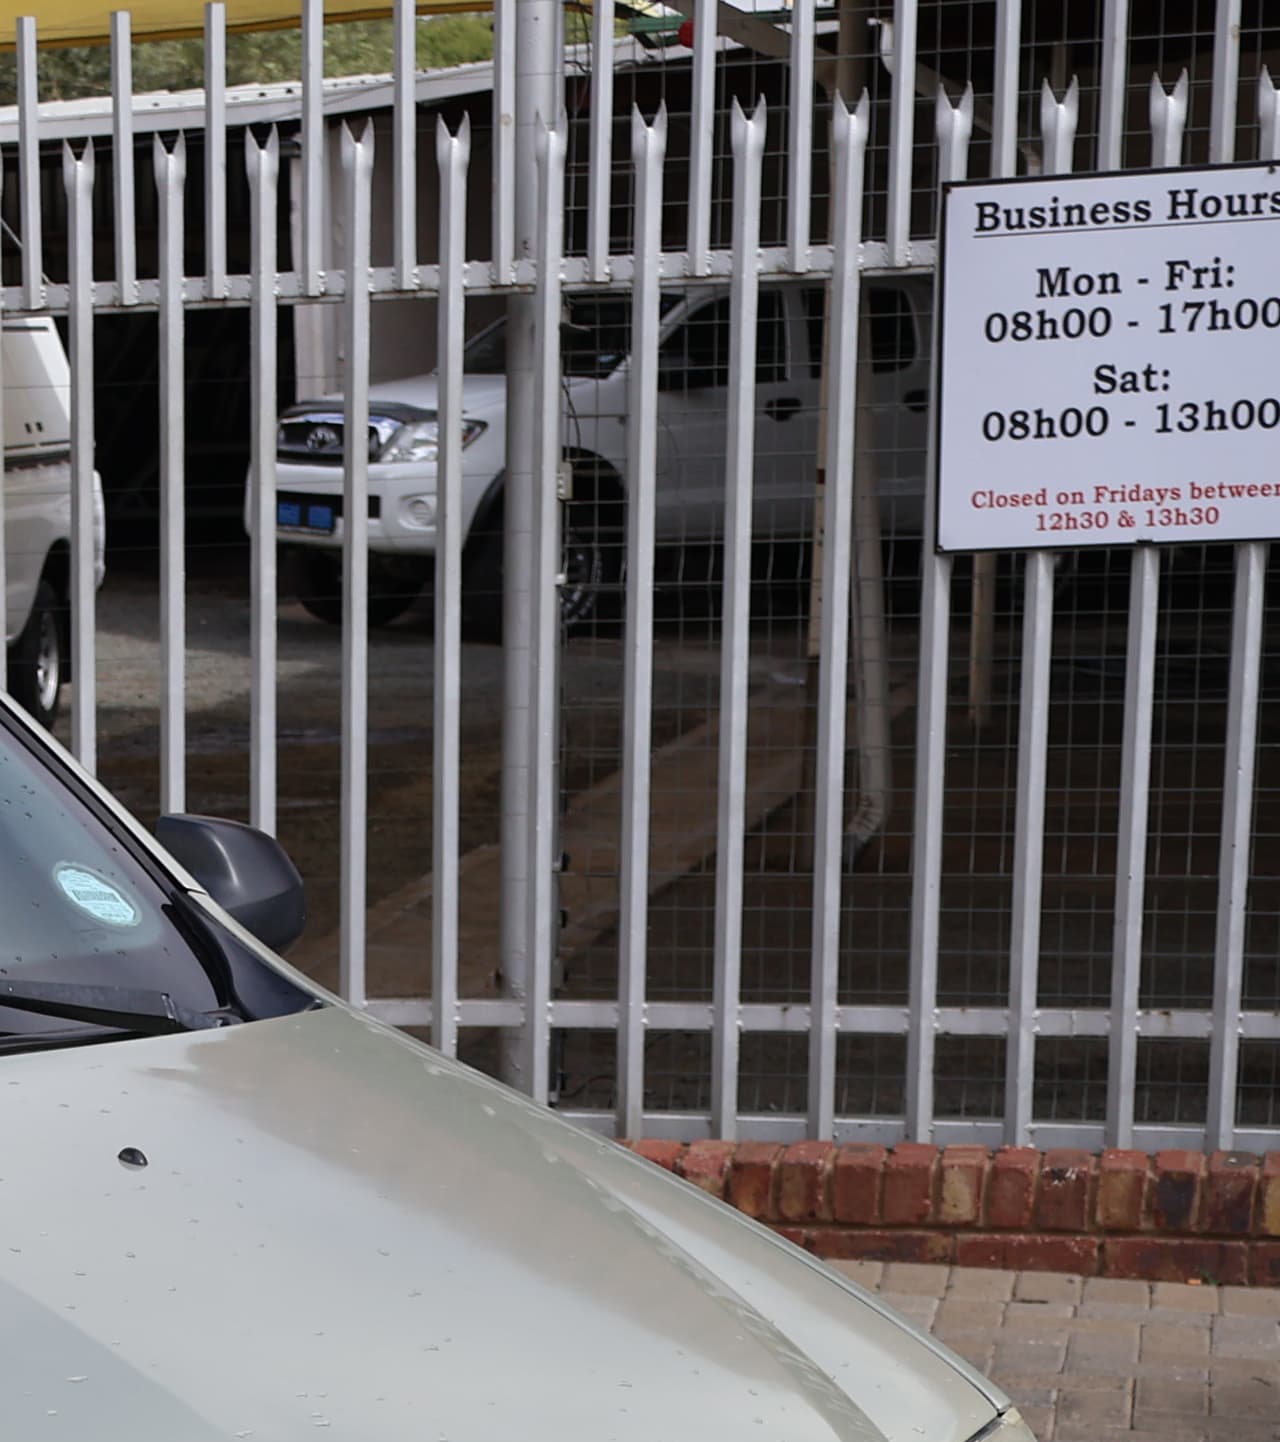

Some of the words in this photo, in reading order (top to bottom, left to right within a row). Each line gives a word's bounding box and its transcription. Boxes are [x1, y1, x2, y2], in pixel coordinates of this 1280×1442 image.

[974, 197, 1152, 233] Business
[1167, 189, 1280, 220] Hours
[1036, 267, 1122, 298] Mon
[1165, 257, 1235, 290] Fri:
[985, 307, 1112, 342] 08h00
[1158, 297, 1280, 333] 17h00
[1094, 363, 1171, 394] Sat:
[982, 406, 1109, 441] 08h00
[1155, 398, 1280, 433] 13h00
[971, 488, 1047, 509] Closed
[1056, 490, 1085, 505] on
[1093, 483, 1182, 506] Fridays
[1036, 510, 1109, 531] 12h30
[1117, 514, 1136, 528] &
[1145, 506, 1220, 527] 13h30
